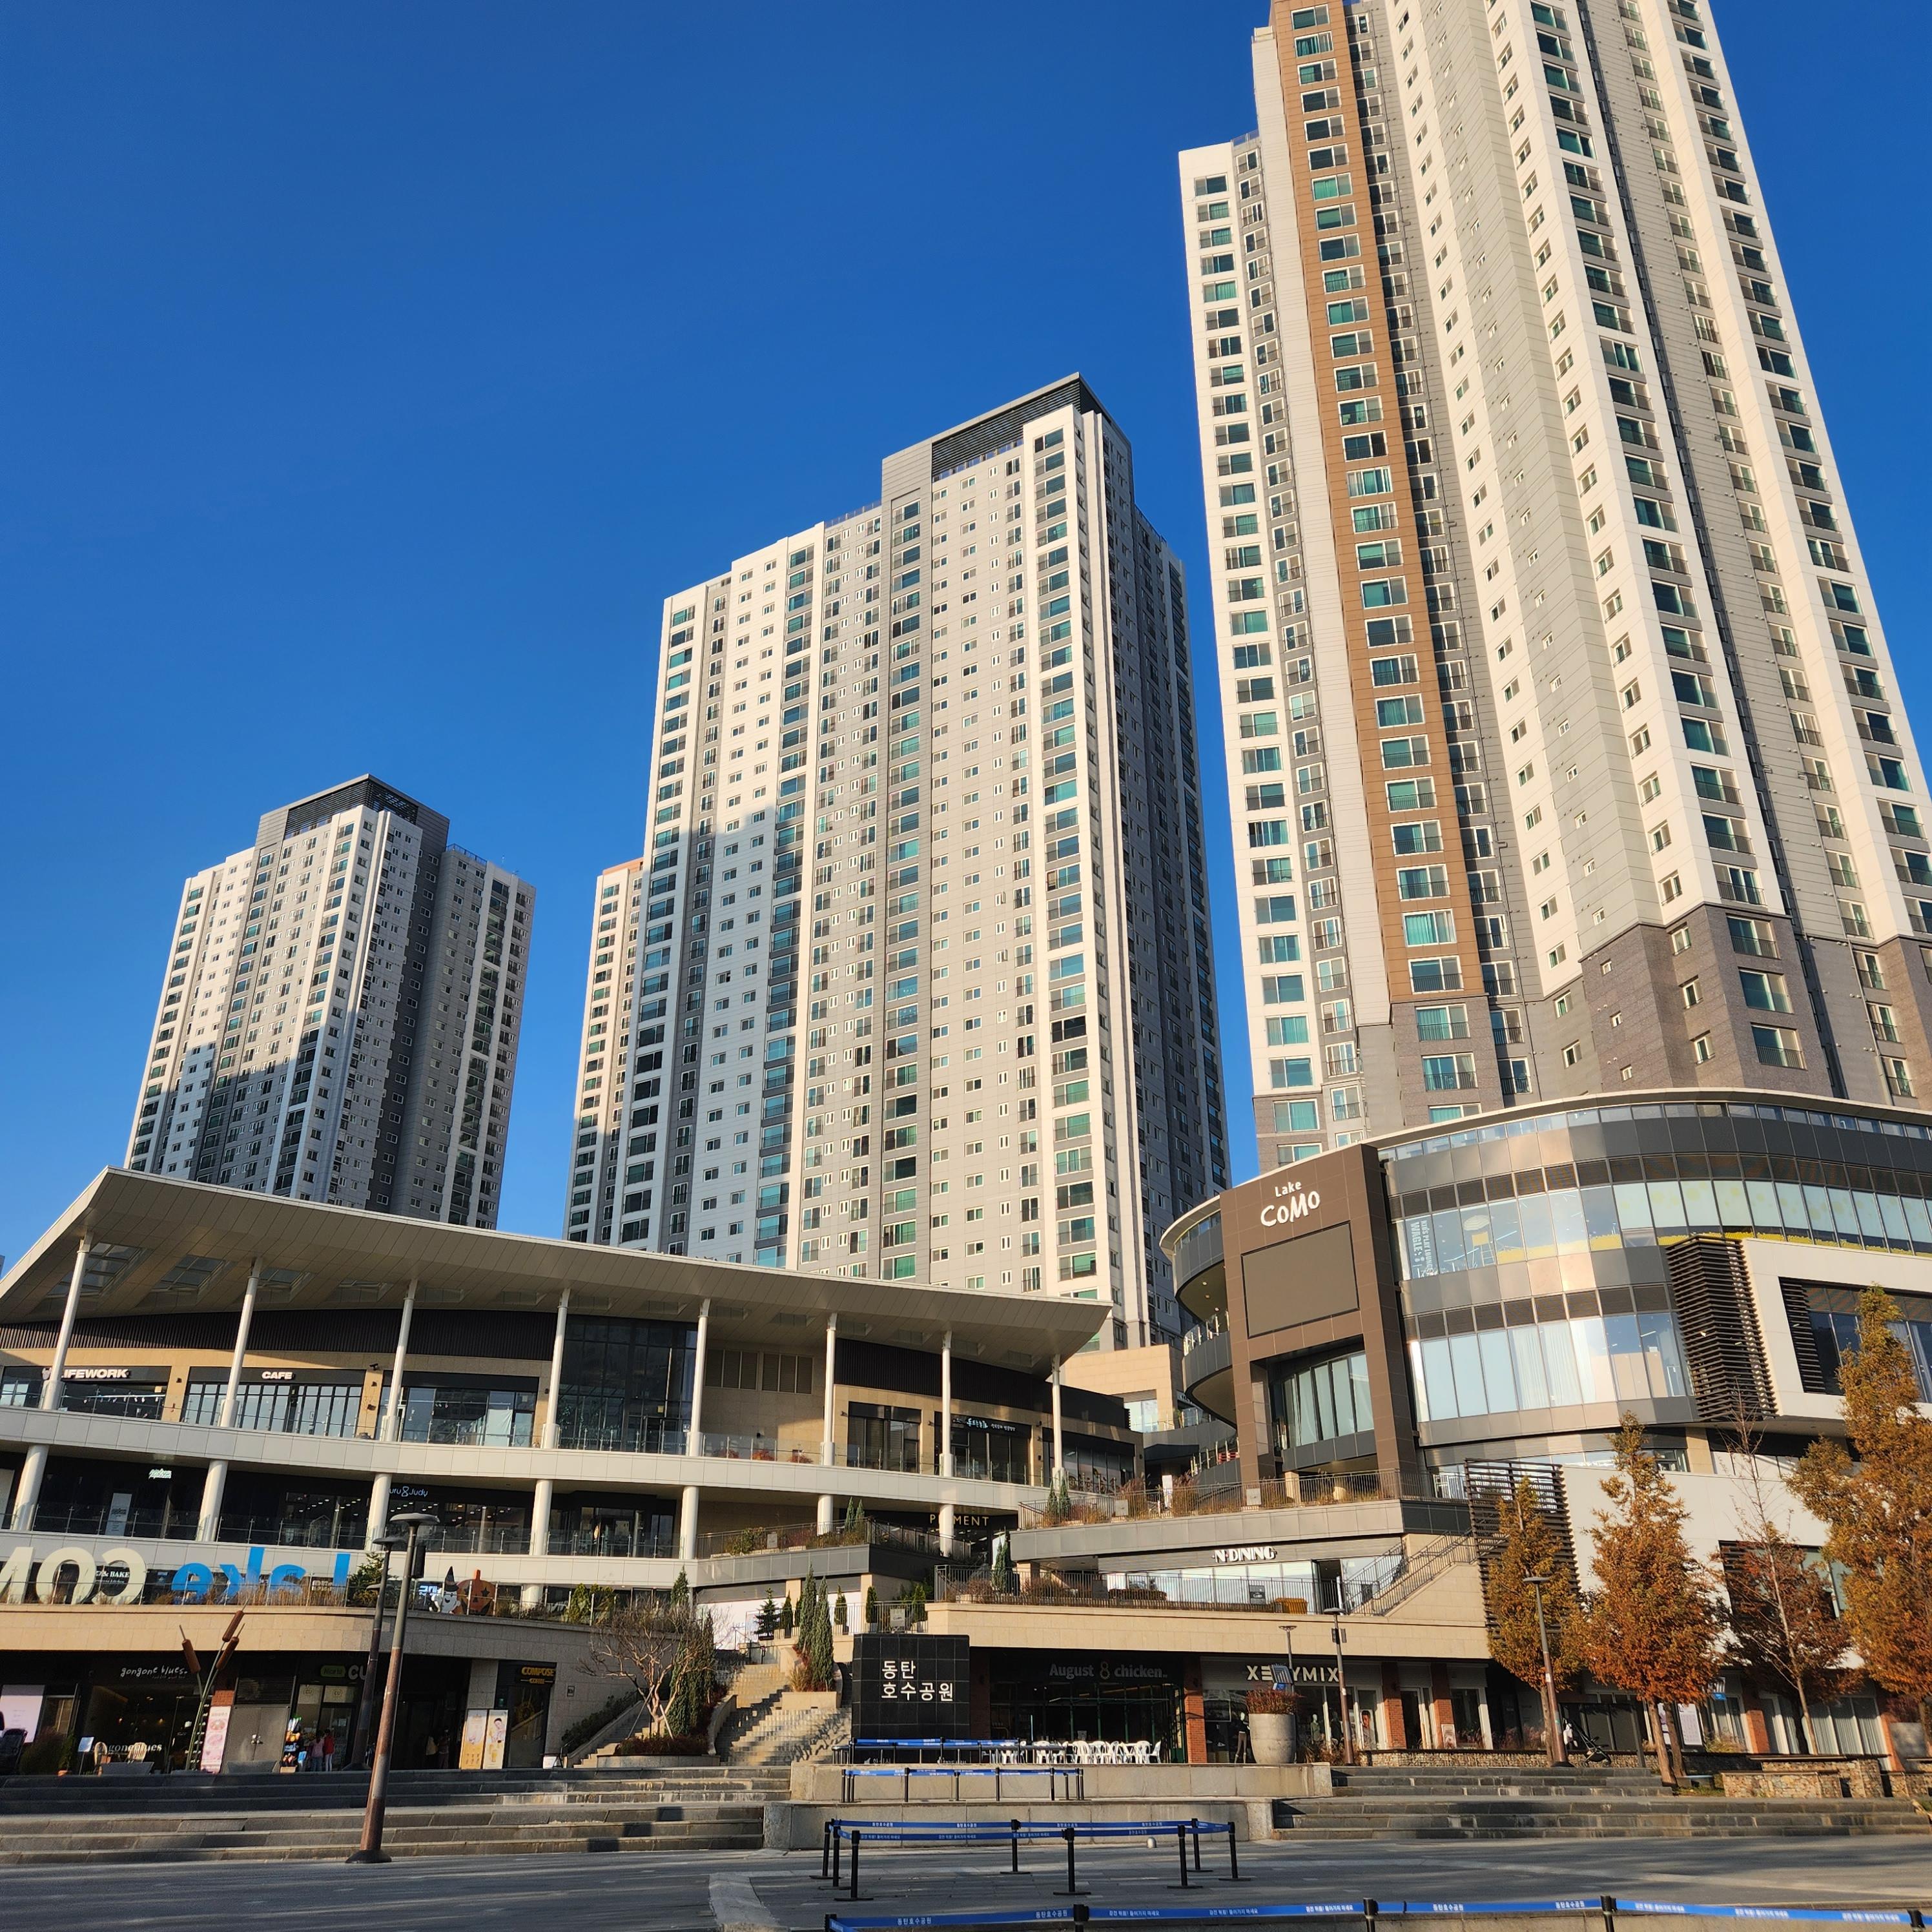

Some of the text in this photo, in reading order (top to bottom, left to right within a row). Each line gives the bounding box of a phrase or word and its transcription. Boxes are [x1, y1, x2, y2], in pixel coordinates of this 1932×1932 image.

[1275, 1181, 1302, 1197] Lake
[262, 1371, 293, 1380] CAFE
[120, 1667, 158, 1678] gongone
[521, 1666, 555, 1677] COMPOSE
[882, 1660, 916, 1680] 동탄
[1049, 1663, 1094, 1680] August
[1246, 1665, 1339, 1683] XEYMIX
[881, 1681, 953, 1702] 호수공원
[1036, 1909, 1067, 1918] 동탄호수공원
[897, 1917, 932, 1926] 동탄호수공원
